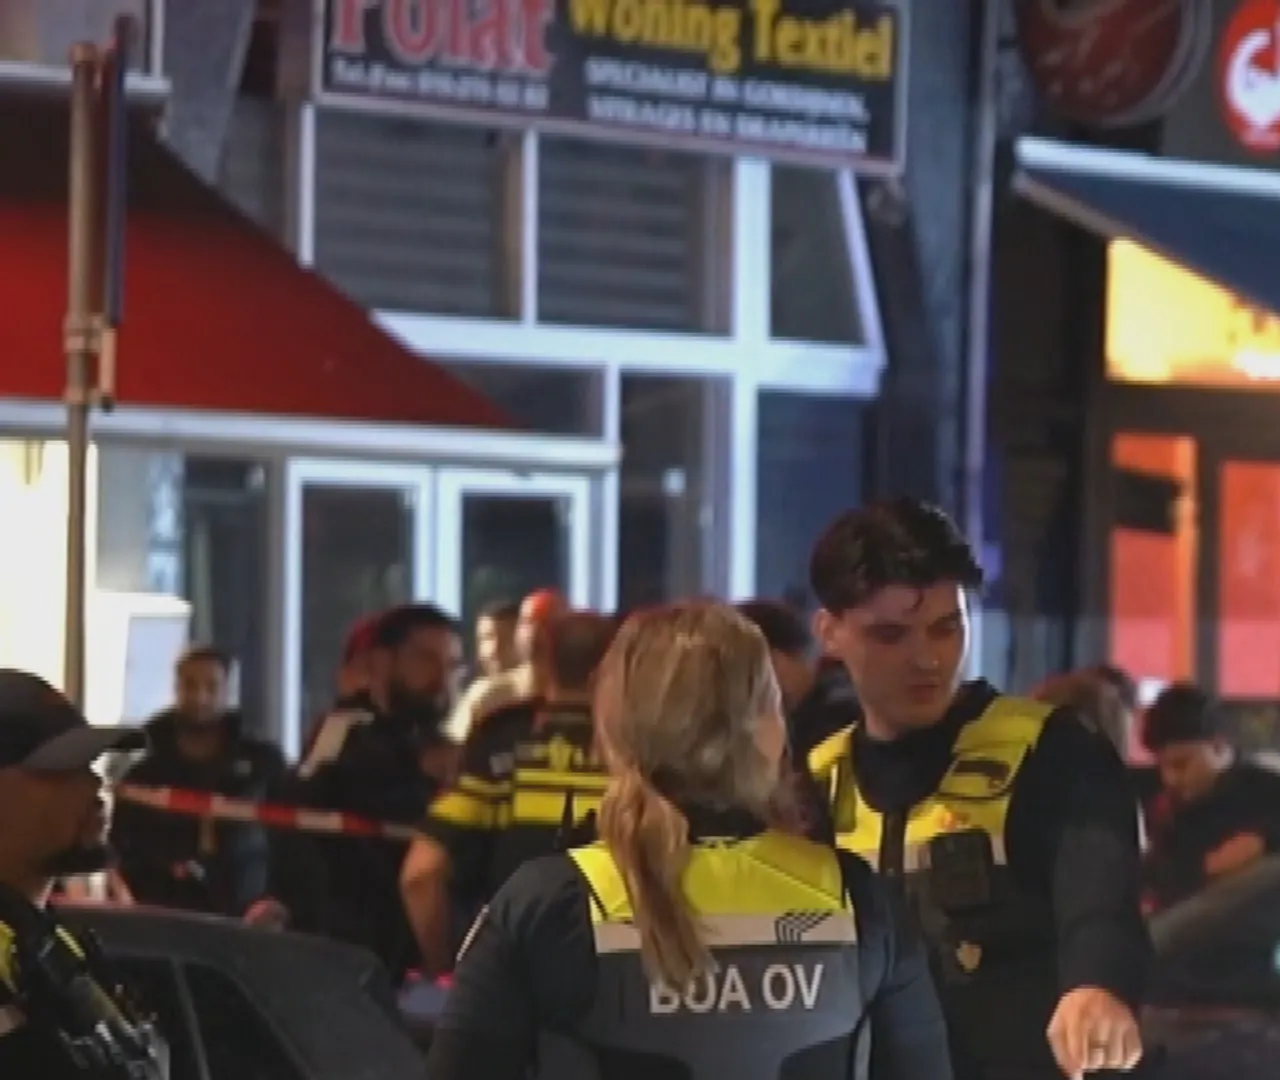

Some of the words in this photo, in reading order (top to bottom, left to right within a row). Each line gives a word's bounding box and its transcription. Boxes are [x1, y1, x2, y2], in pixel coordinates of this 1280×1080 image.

[570, 0, 741, 74] Woning
[753, 0, 894, 81] Textiel
[650, 964, 751, 1013] BOA
[762, 963, 823, 1010] OV
